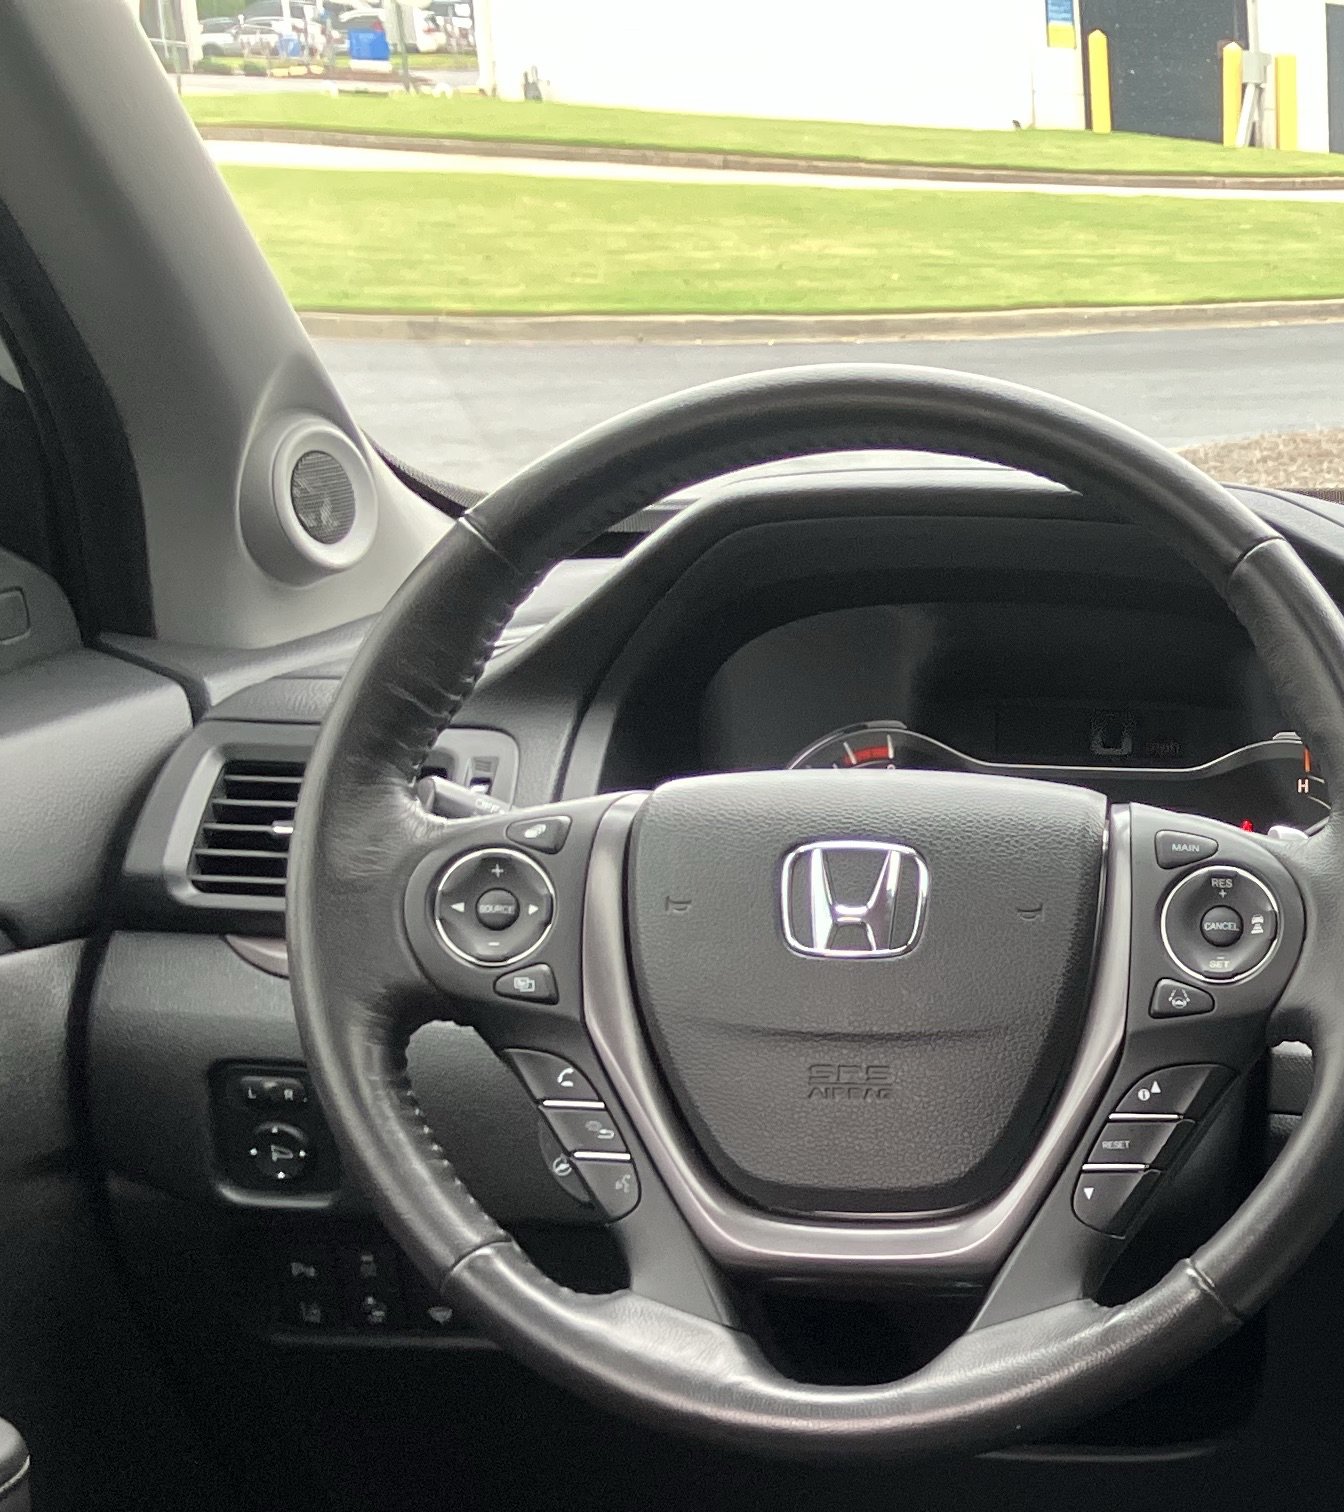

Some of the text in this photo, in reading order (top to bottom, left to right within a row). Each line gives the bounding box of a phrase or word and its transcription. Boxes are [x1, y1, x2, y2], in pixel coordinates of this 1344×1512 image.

[1297, 778, 1310, 794] H
[1171, 843, 1201, 853] MAIN
[1211, 878, 1233, 889] RES
[479, 903, 514, 915] SOURCE
[1204, 921, 1241, 932] CANCEL
[1209, 959, 1231, 969] SET
[1101, 1140, 1130, 1150] RESET
